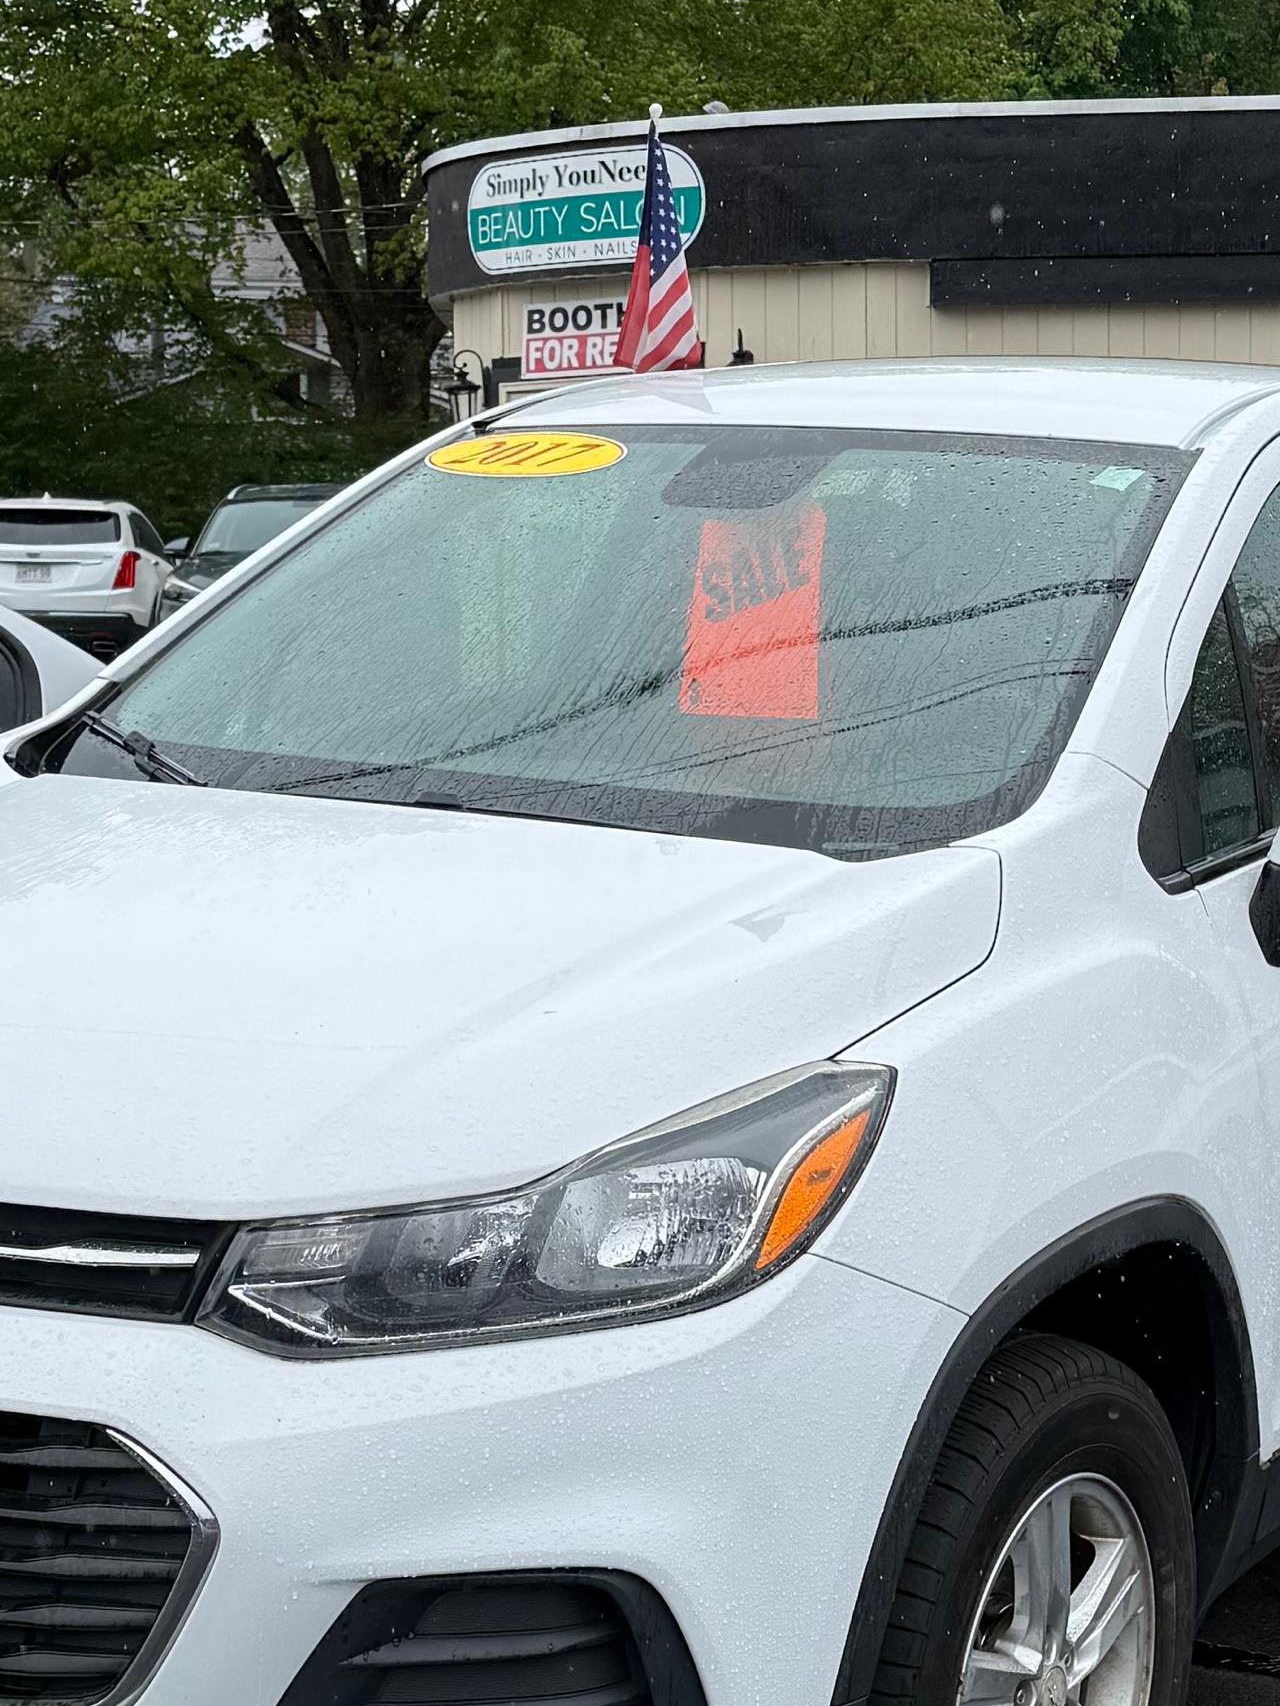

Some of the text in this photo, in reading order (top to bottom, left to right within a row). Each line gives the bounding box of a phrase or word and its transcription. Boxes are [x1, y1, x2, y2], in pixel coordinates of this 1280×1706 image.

[486, 159, 646, 199] Simply YouNee
[478, 204, 568, 245] BEAUTY
[505, 241, 637, 264] HAIR SKIN NAILS
[528, 335, 619, 371] FOR RE
[443, 441, 606, 467] 2017
[702, 543, 811, 623] SALE
